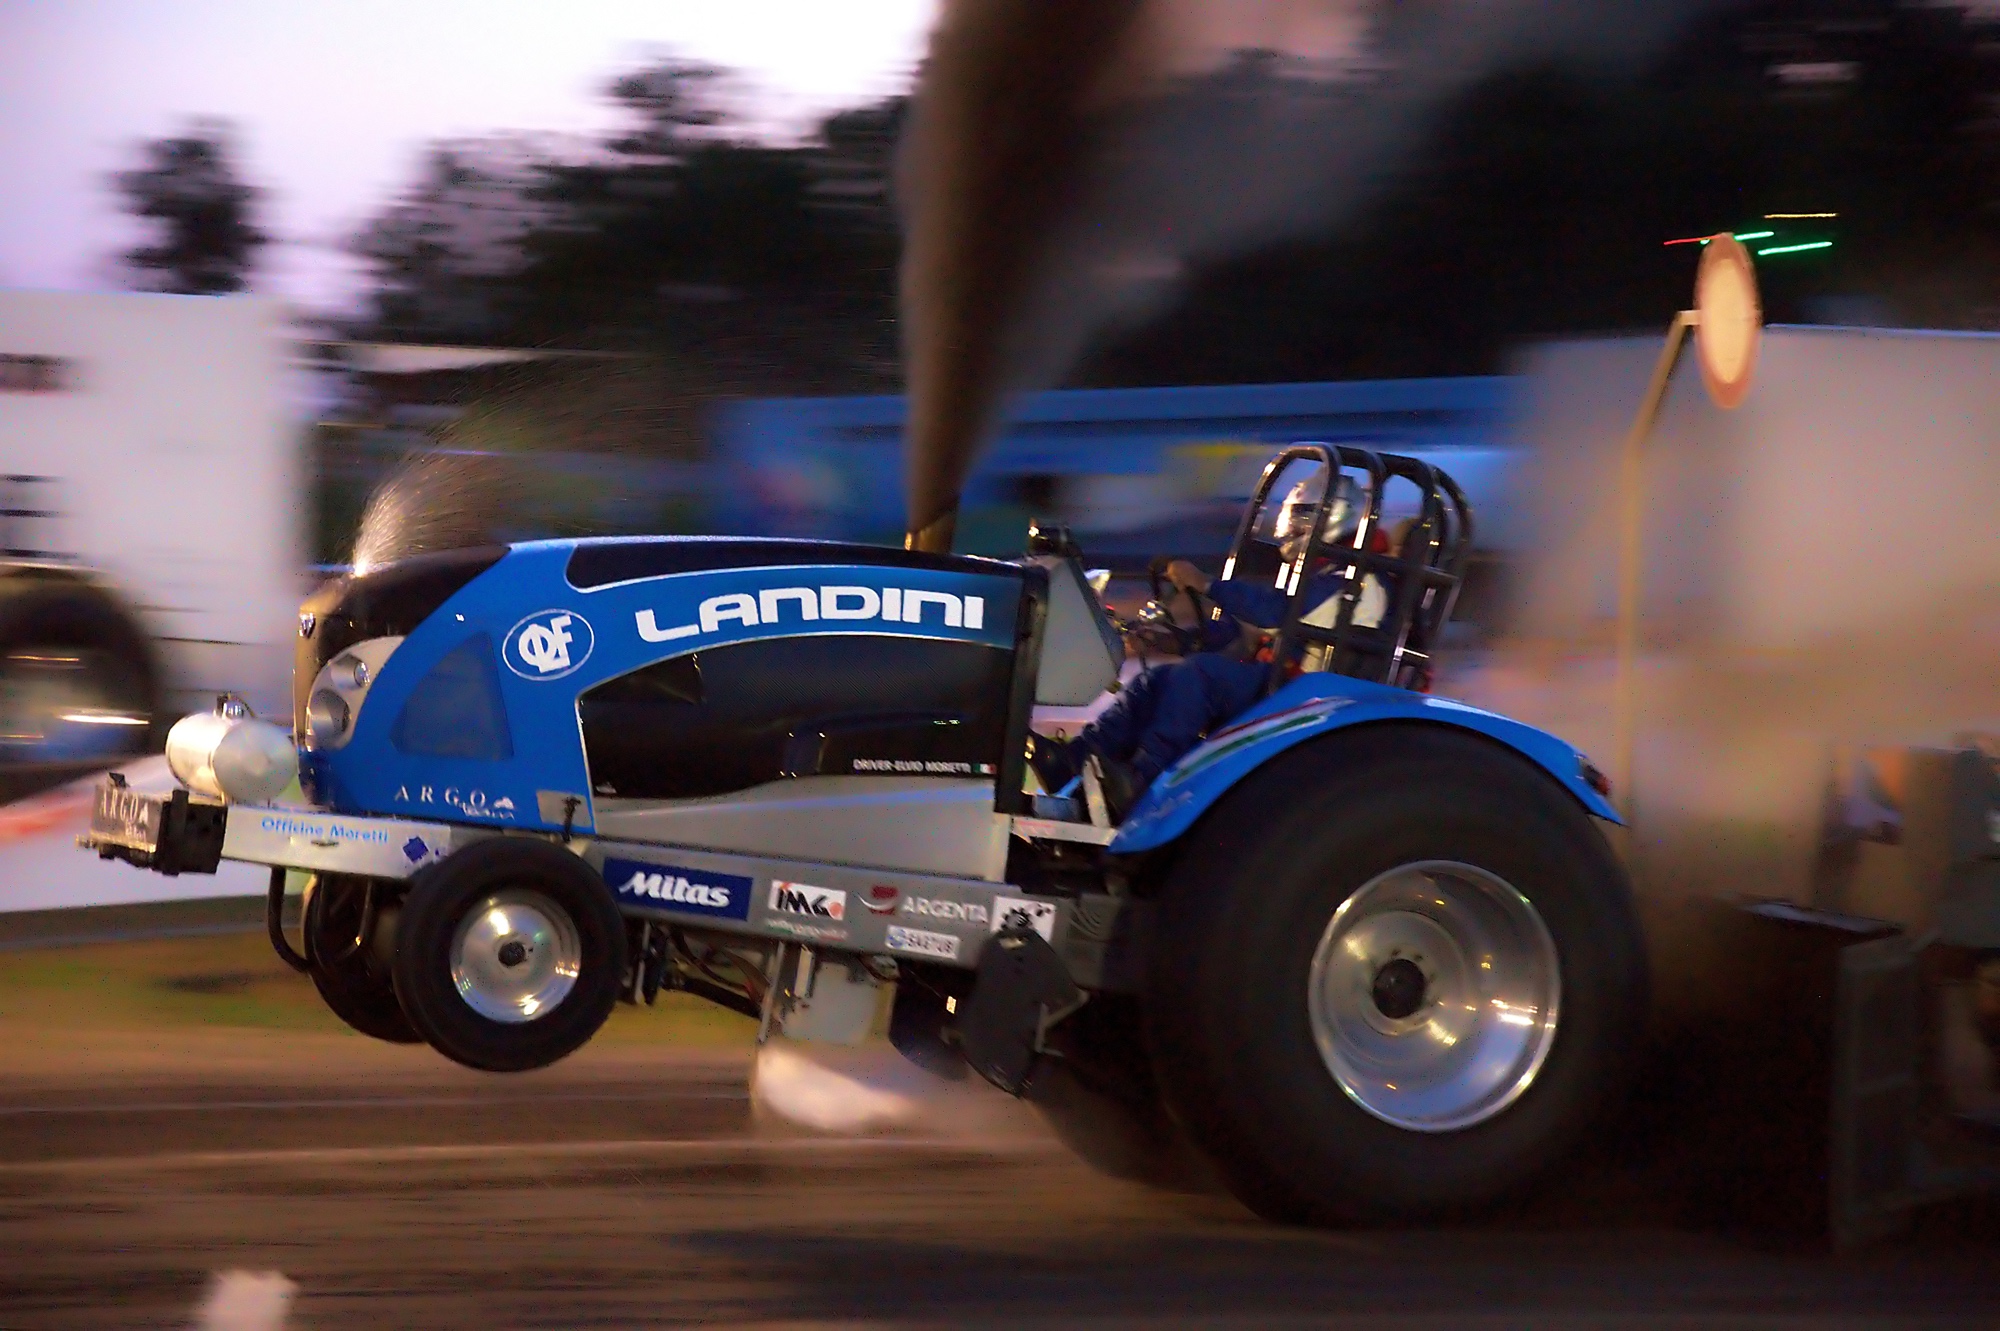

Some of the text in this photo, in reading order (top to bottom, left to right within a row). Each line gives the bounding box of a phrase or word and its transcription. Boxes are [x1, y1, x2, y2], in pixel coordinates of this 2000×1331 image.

[636, 586, 985, 643] LANDINI
[100, 788, 139, 822] ARGO
[395, 784, 486, 809] ARGO
[262, 816, 389, 844] Officine Moretti
[618, 870, 731, 908] Mitas
[902, 895, 989, 925] ARGENTA
